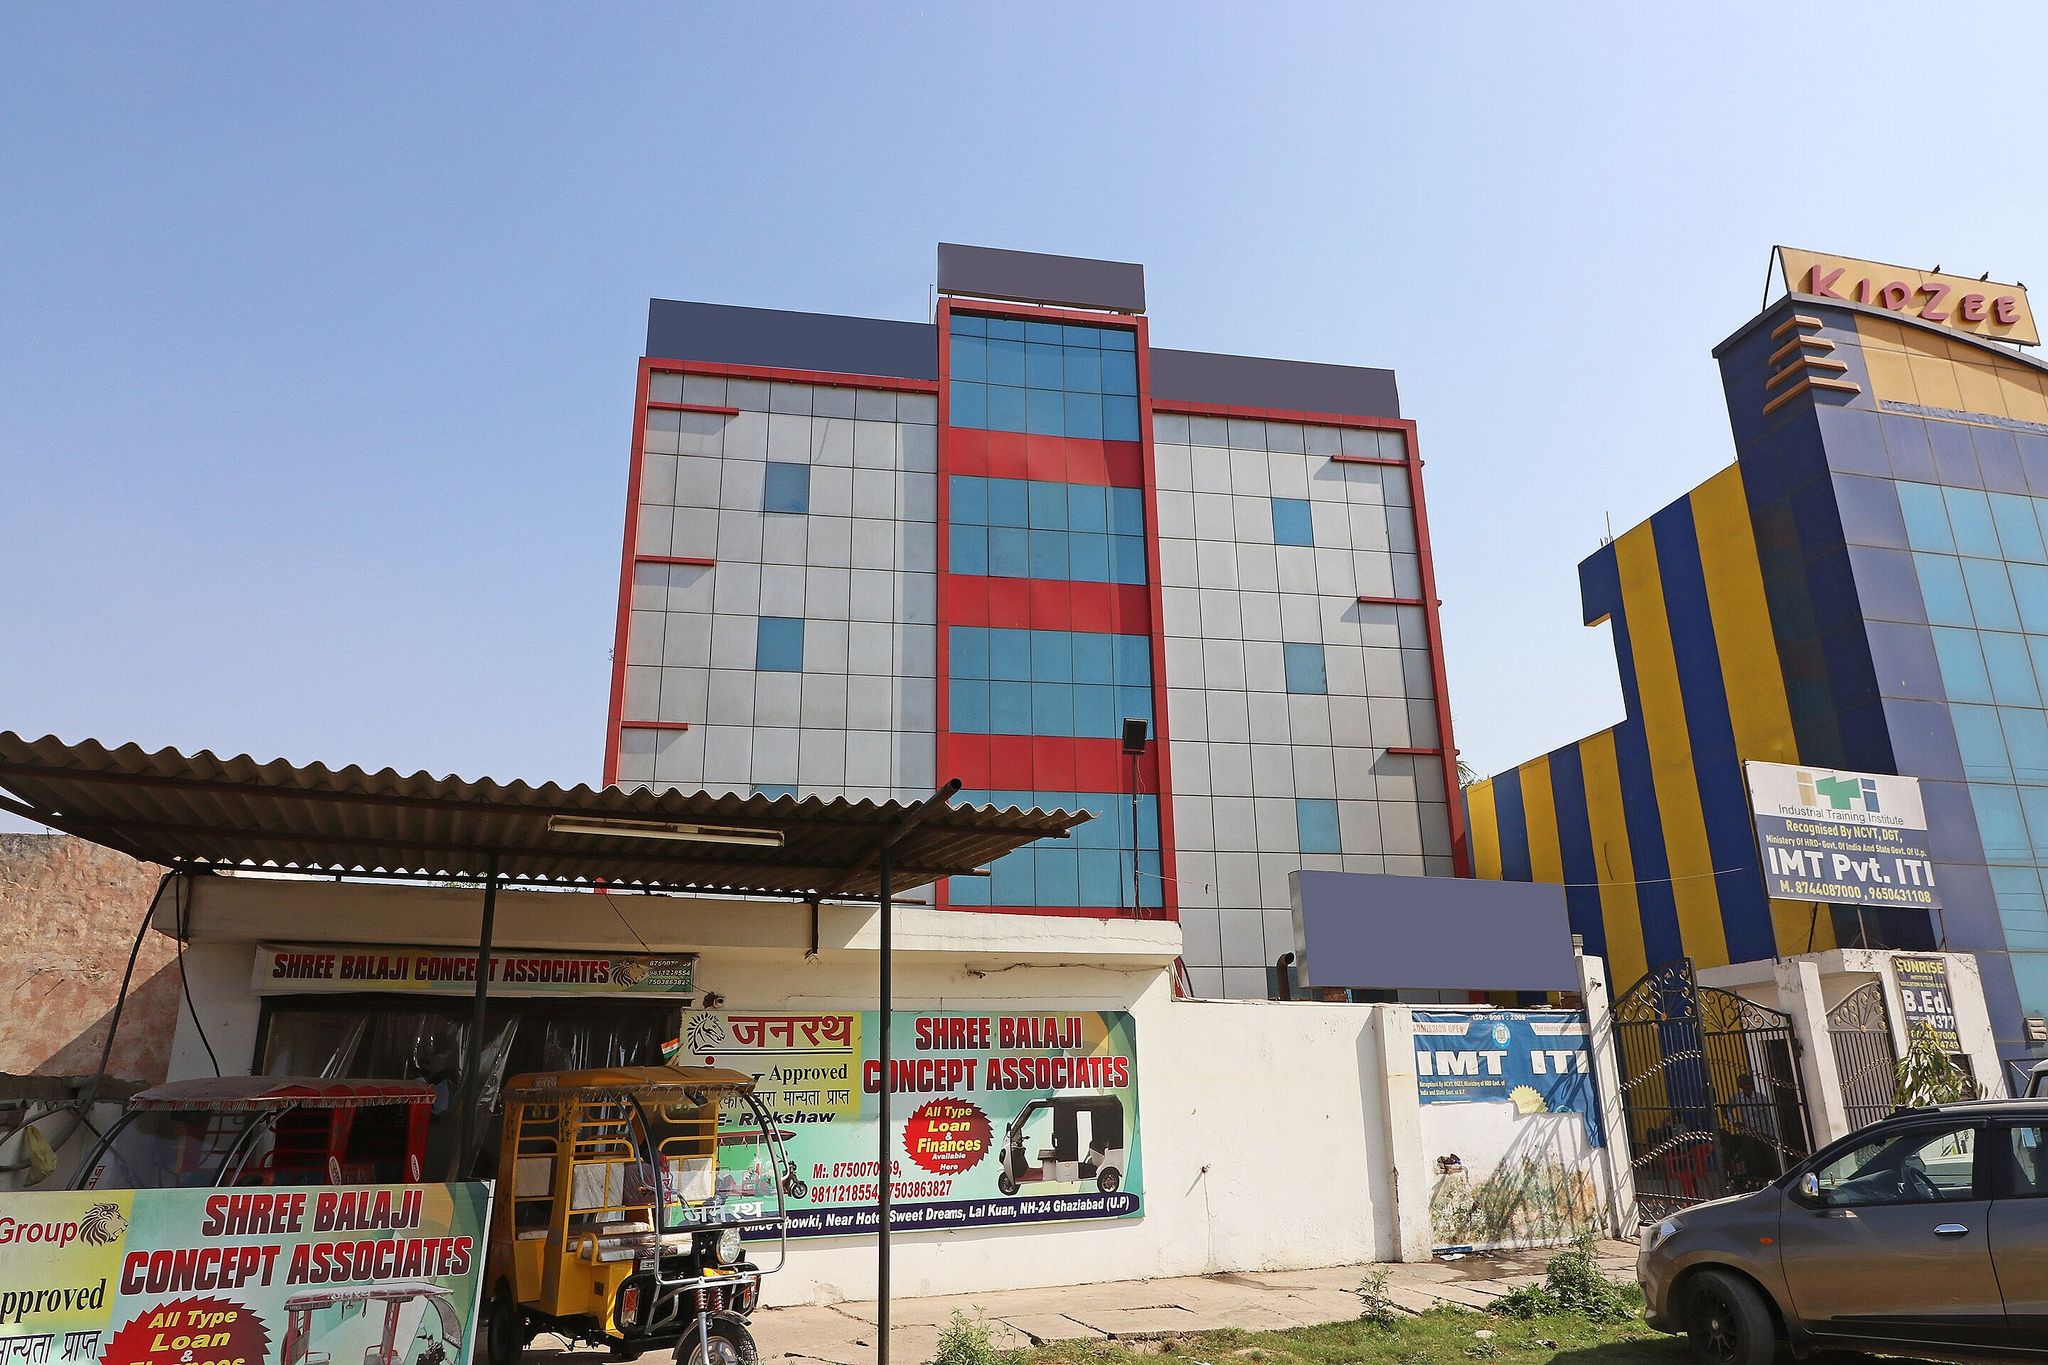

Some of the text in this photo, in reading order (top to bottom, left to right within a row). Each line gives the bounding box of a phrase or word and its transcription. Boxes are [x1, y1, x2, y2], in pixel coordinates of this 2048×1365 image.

[1809, 264, 2021, 325] KIDZEE
[1778, 803, 1904, 826] Industrial Training Institute
[1786, 819, 1903, 843] Recognised By NCVT, DGT,
[1797, 838, 1804, 846] Of
[1838, 843, 1846, 851] Of
[1846, 843, 1861, 852] India
[1862, 844, 1875, 853] And
[1875, 845, 1891, 854] State
[1906, 848, 1914, 856] Of
[1768, 847, 1935, 887] IMT Pvt. ITI
[1780, 879, 1794, 893] M.
[1795, 881, 1861, 899] 8744087000
[271, 953, 610, 985] SHREE BALAJI CONCET ASSOCIATES
[1896, 960, 1945, 975] SUNRISE
[1902, 990, 1952, 1013] B.Ed.
[728, 1015, 854, 1047] जनरथ
[915, 1017, 1082, 1051] SHREE BALAJI
[1413, 1024, 1447, 1033] ADMISSION
[986, 1056, 1129, 1090] ASSOCIATES
[1417, 1050, 1589, 1076] IMT ITI
[769, 1064, 848, 1085] Approved
[783, 1090, 821, 1107] मान्यता
[924, 1105, 973, 1118] All Type
[927, 1120, 971, 1133] Loan
[944, 1131, 953, 1141] &
[917, 1137, 982, 1154] Finances
[931, 1152, 967, 1161] Available
[940, 1163, 959, 1171] Here
[201, 1190, 422, 1237] SHREE BALAJI
[826, 1212, 852, 1227] Near
[856, 1210, 880, 1224] Hote
[890, 1208, 923, 1224] Sweet
[925, 1205, 966, 1222] Dreams,
[969, 1204, 986, 1218] Lal
[988, 1202, 1018, 1218] Kuan,
[1020, 1199, 1051, 1214] NH-24
[1053, 1197, 1104, 1212] Ghaziabad
[1106, 1196, 1130, 1210] (U.P)
[0, 1217, 78, 1248] Group
[119, 1236, 474, 1296] CONCEPT ASSOCIATES
[148, 1310, 239, 1329] All Type
[60, 1330, 103, 1363] प्राप्त
[149, 1331, 232, 1353] Loan
[180, 1349, 194, 1363] &
